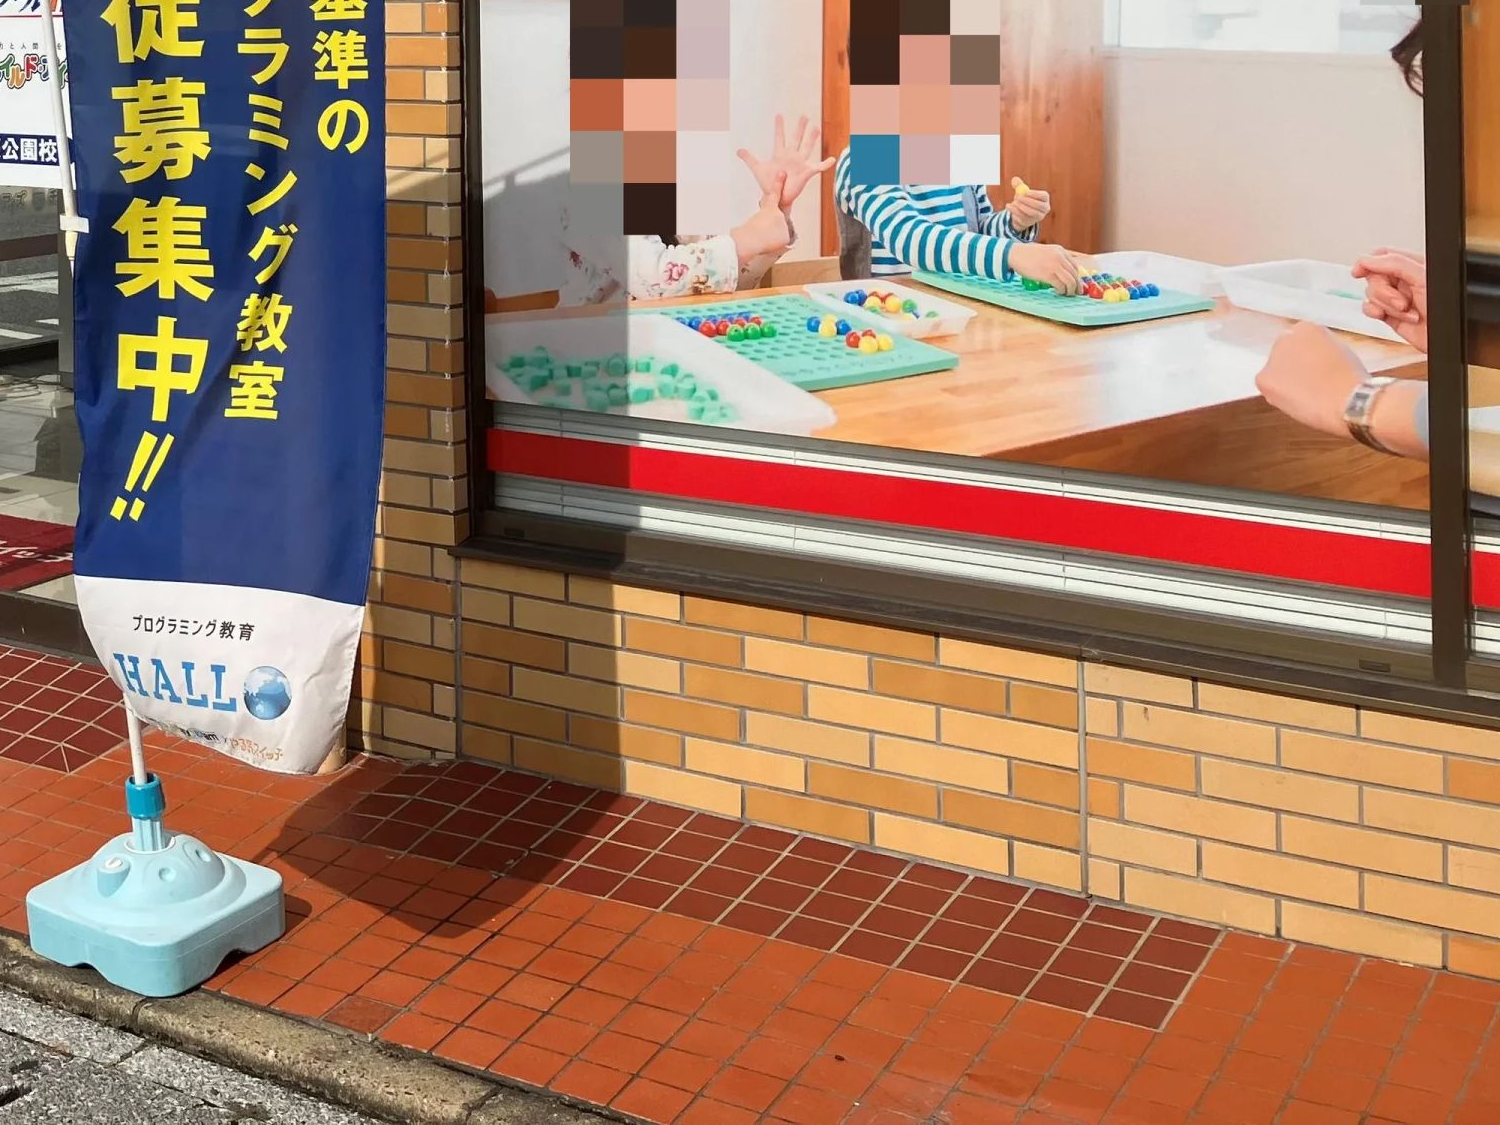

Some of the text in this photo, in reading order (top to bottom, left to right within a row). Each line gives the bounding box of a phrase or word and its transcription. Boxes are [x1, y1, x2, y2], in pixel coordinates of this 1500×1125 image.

[133, 614, 255, 641] プログラミング教育
